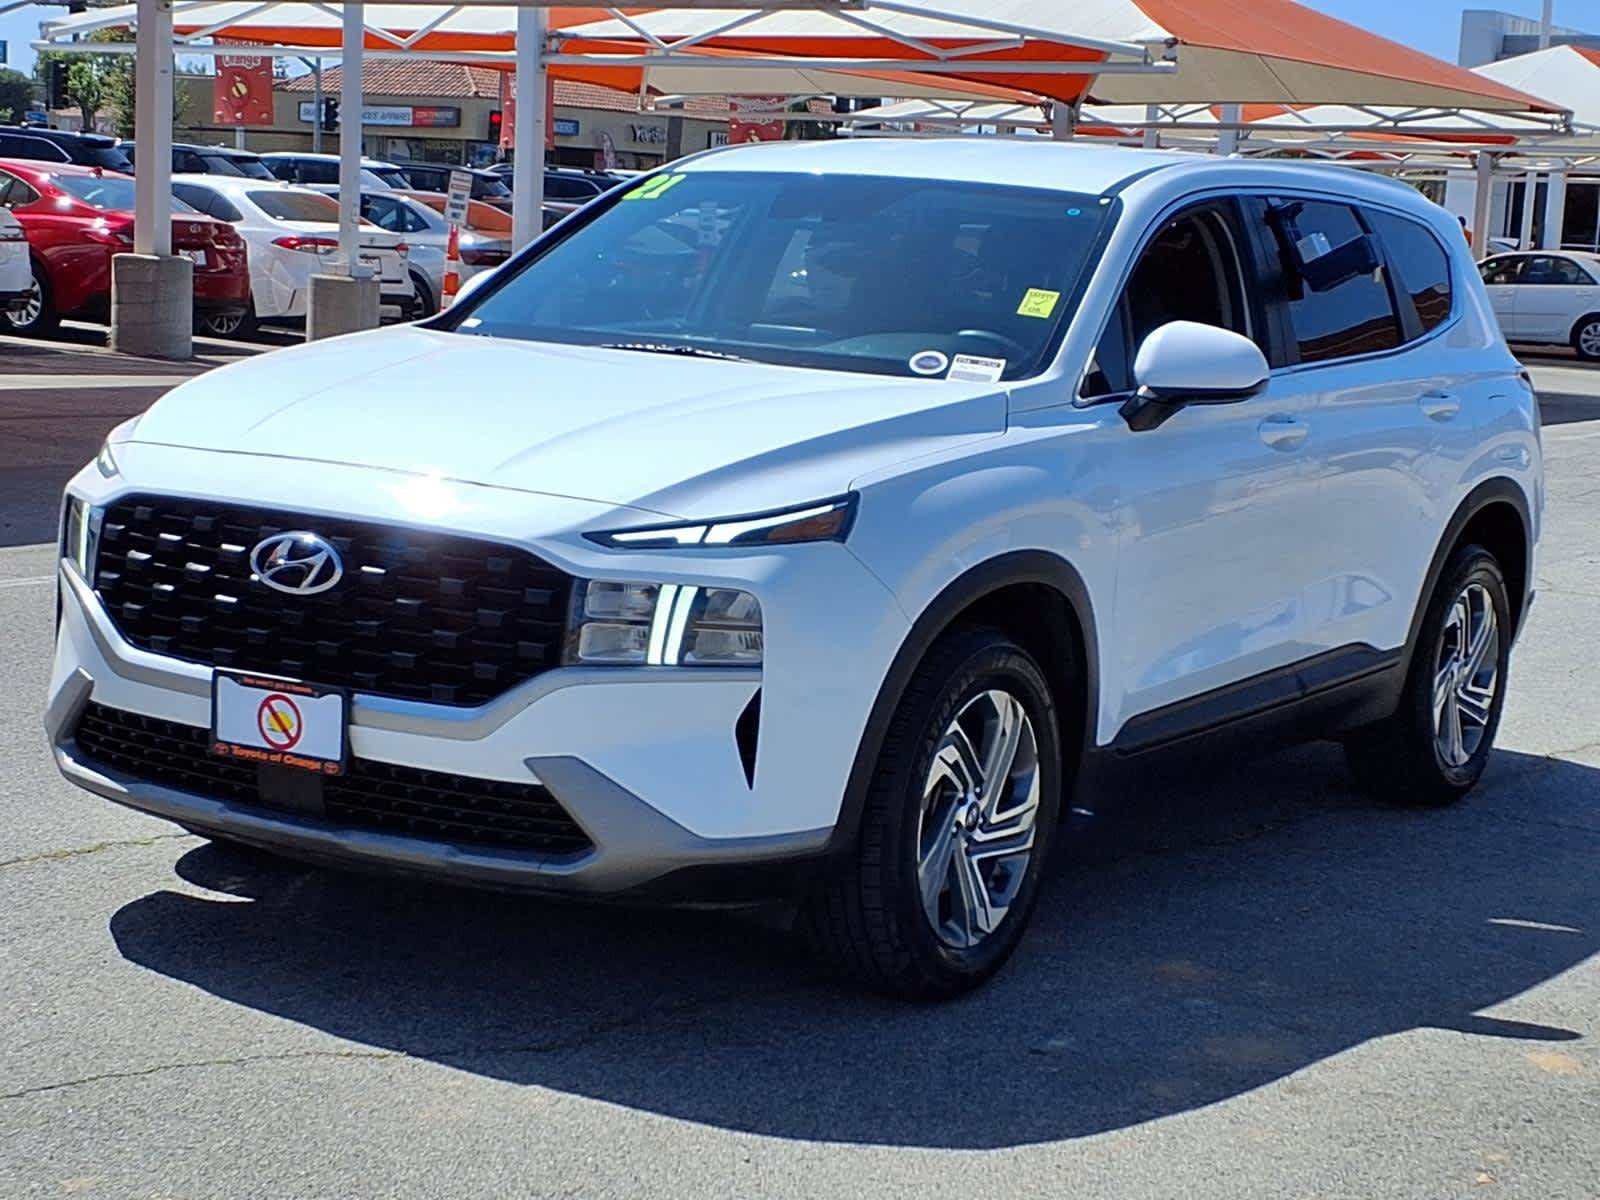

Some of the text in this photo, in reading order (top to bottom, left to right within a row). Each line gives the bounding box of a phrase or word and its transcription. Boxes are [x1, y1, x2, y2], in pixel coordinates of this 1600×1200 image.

[622, 174, 687, 199] 21
[231, 745, 321, 770] Toyota of Orange
